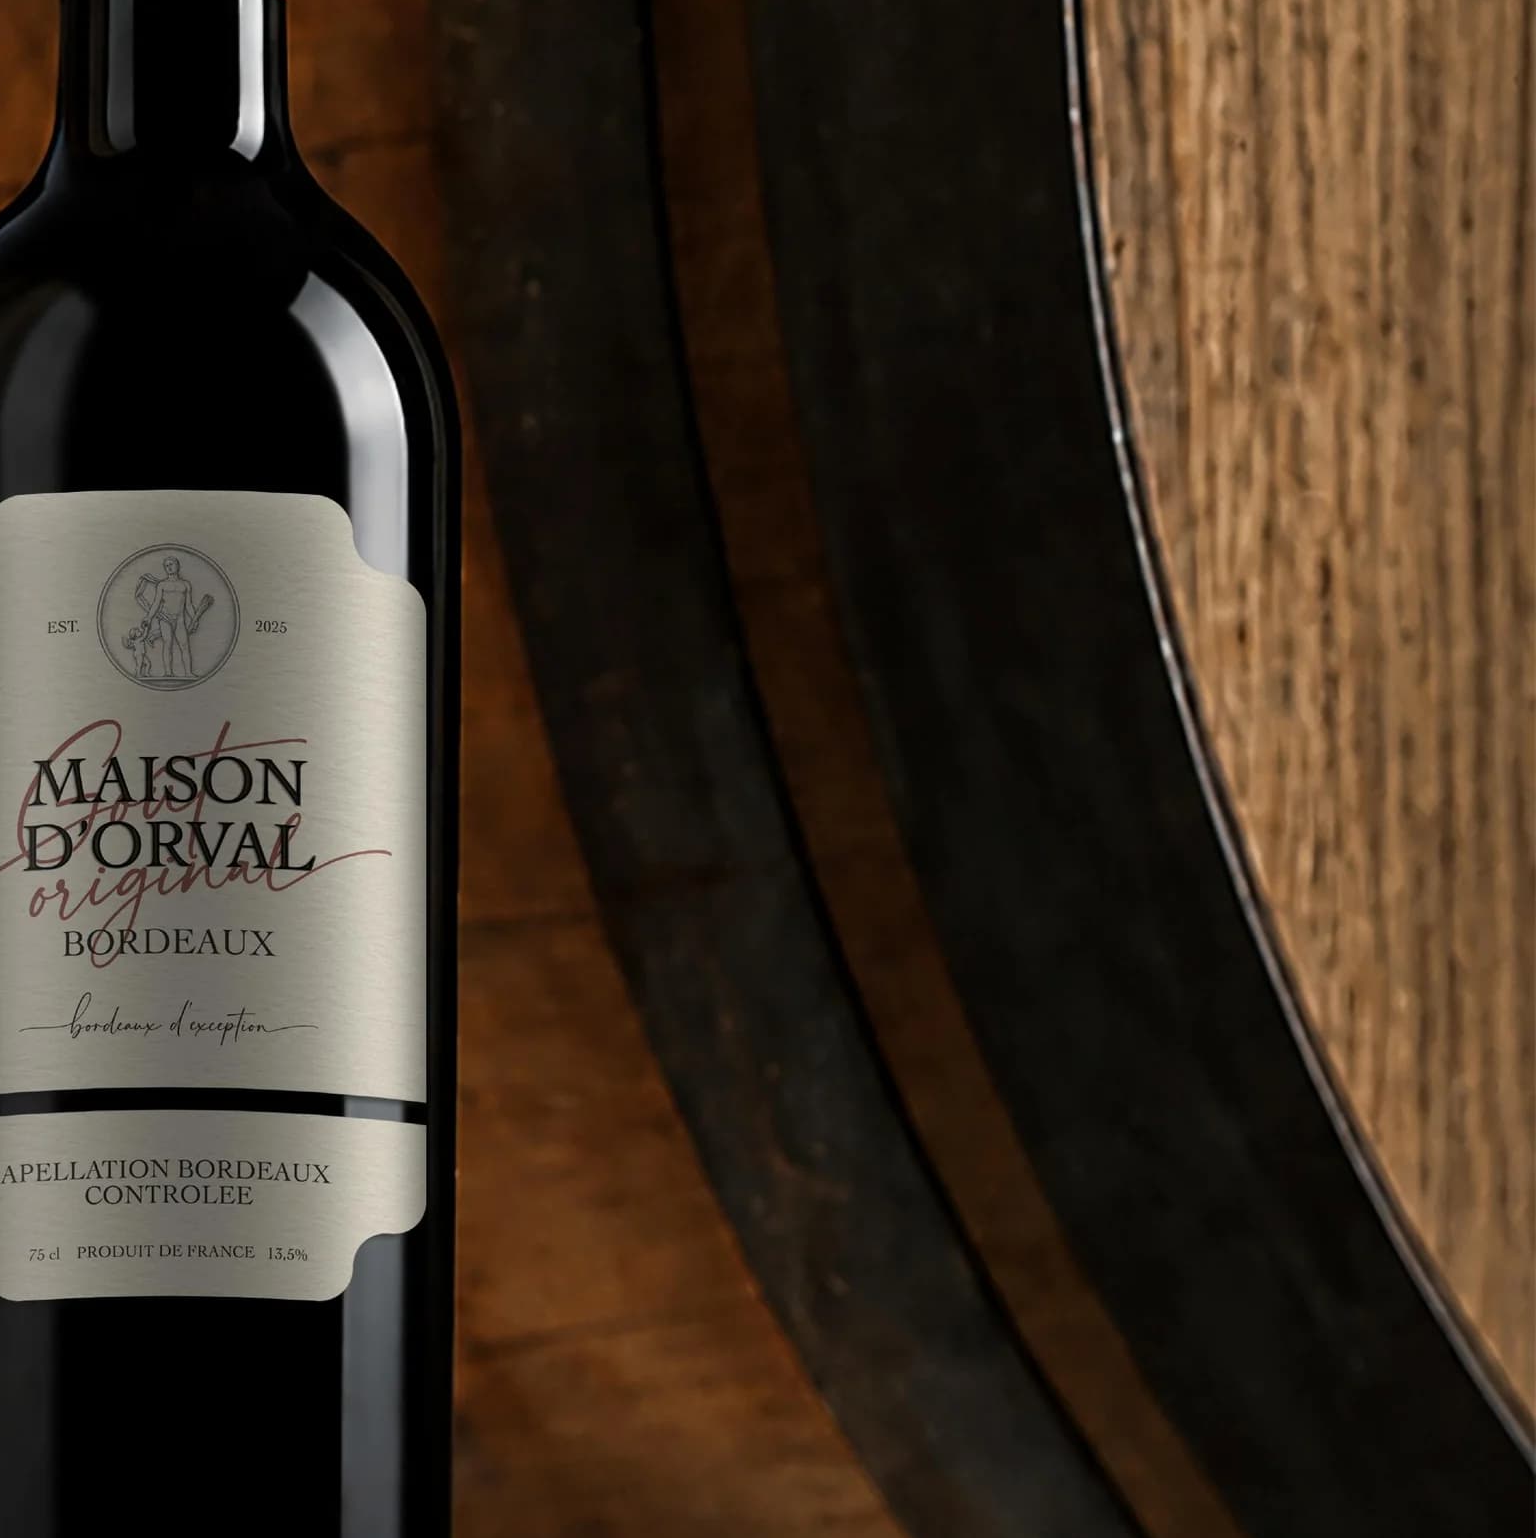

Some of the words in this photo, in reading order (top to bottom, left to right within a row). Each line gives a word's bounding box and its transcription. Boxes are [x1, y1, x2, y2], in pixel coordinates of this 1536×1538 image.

[47, 620, 80, 634] EST.
[255, 619, 288, 634] 2025
[28, 755, 308, 807] MAISON
[22, 820, 317, 872] D'ORVAL
[63, 927, 277, 958] BORDEAUX
[19, 991, 163, 1040] bordeaux
[0, 1158, 169, 1185] APELLATION
[177, 1158, 332, 1185] BORDEAUX
[84, 1184, 254, 1206] CONTROLEE
[28, 1248, 46, 1262] 75
[48, 1246, 61, 1261] cl
[76, 1244, 155, 1260] PRODUIT
[159, 1244, 183, 1259] DE
[187, 1244, 256, 1259] FRANCE
